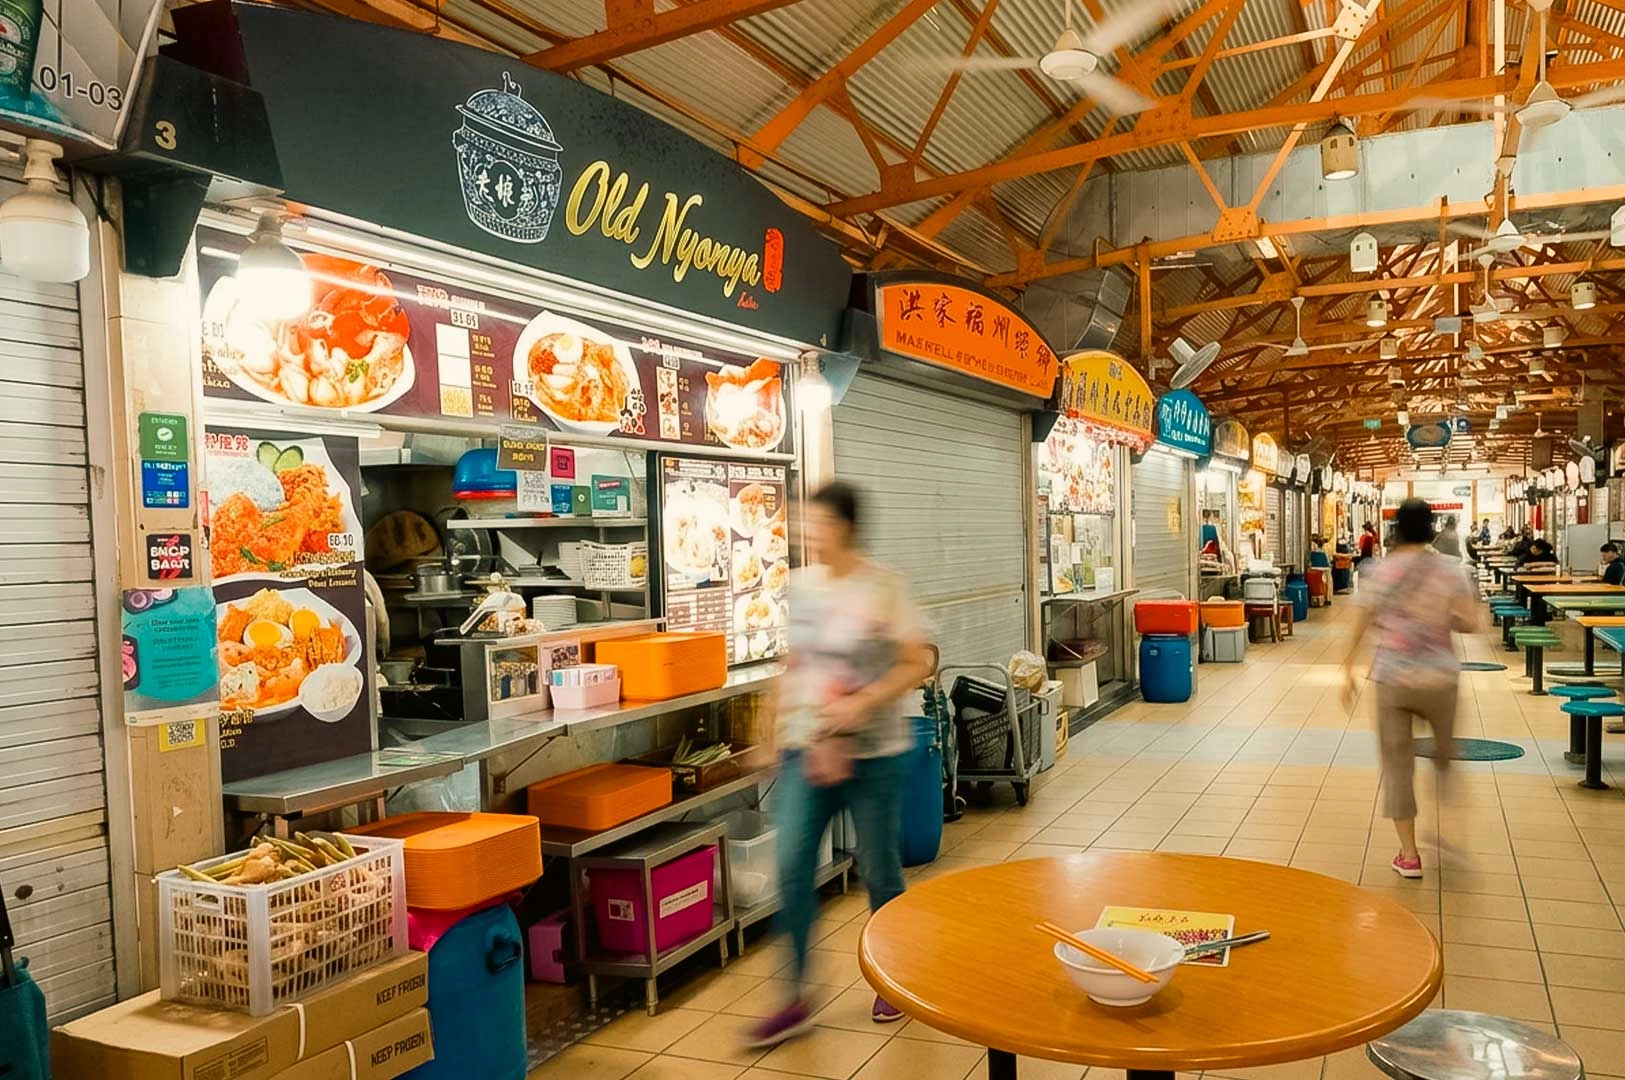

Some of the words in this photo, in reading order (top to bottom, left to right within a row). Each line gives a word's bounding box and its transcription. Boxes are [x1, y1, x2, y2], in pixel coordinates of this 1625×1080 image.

[40, 66, 122, 110] 01-03
[154, 120, 177, 150] 3
[566, 161, 649, 244] Old
[631, 192, 762, 298] Nyonya
